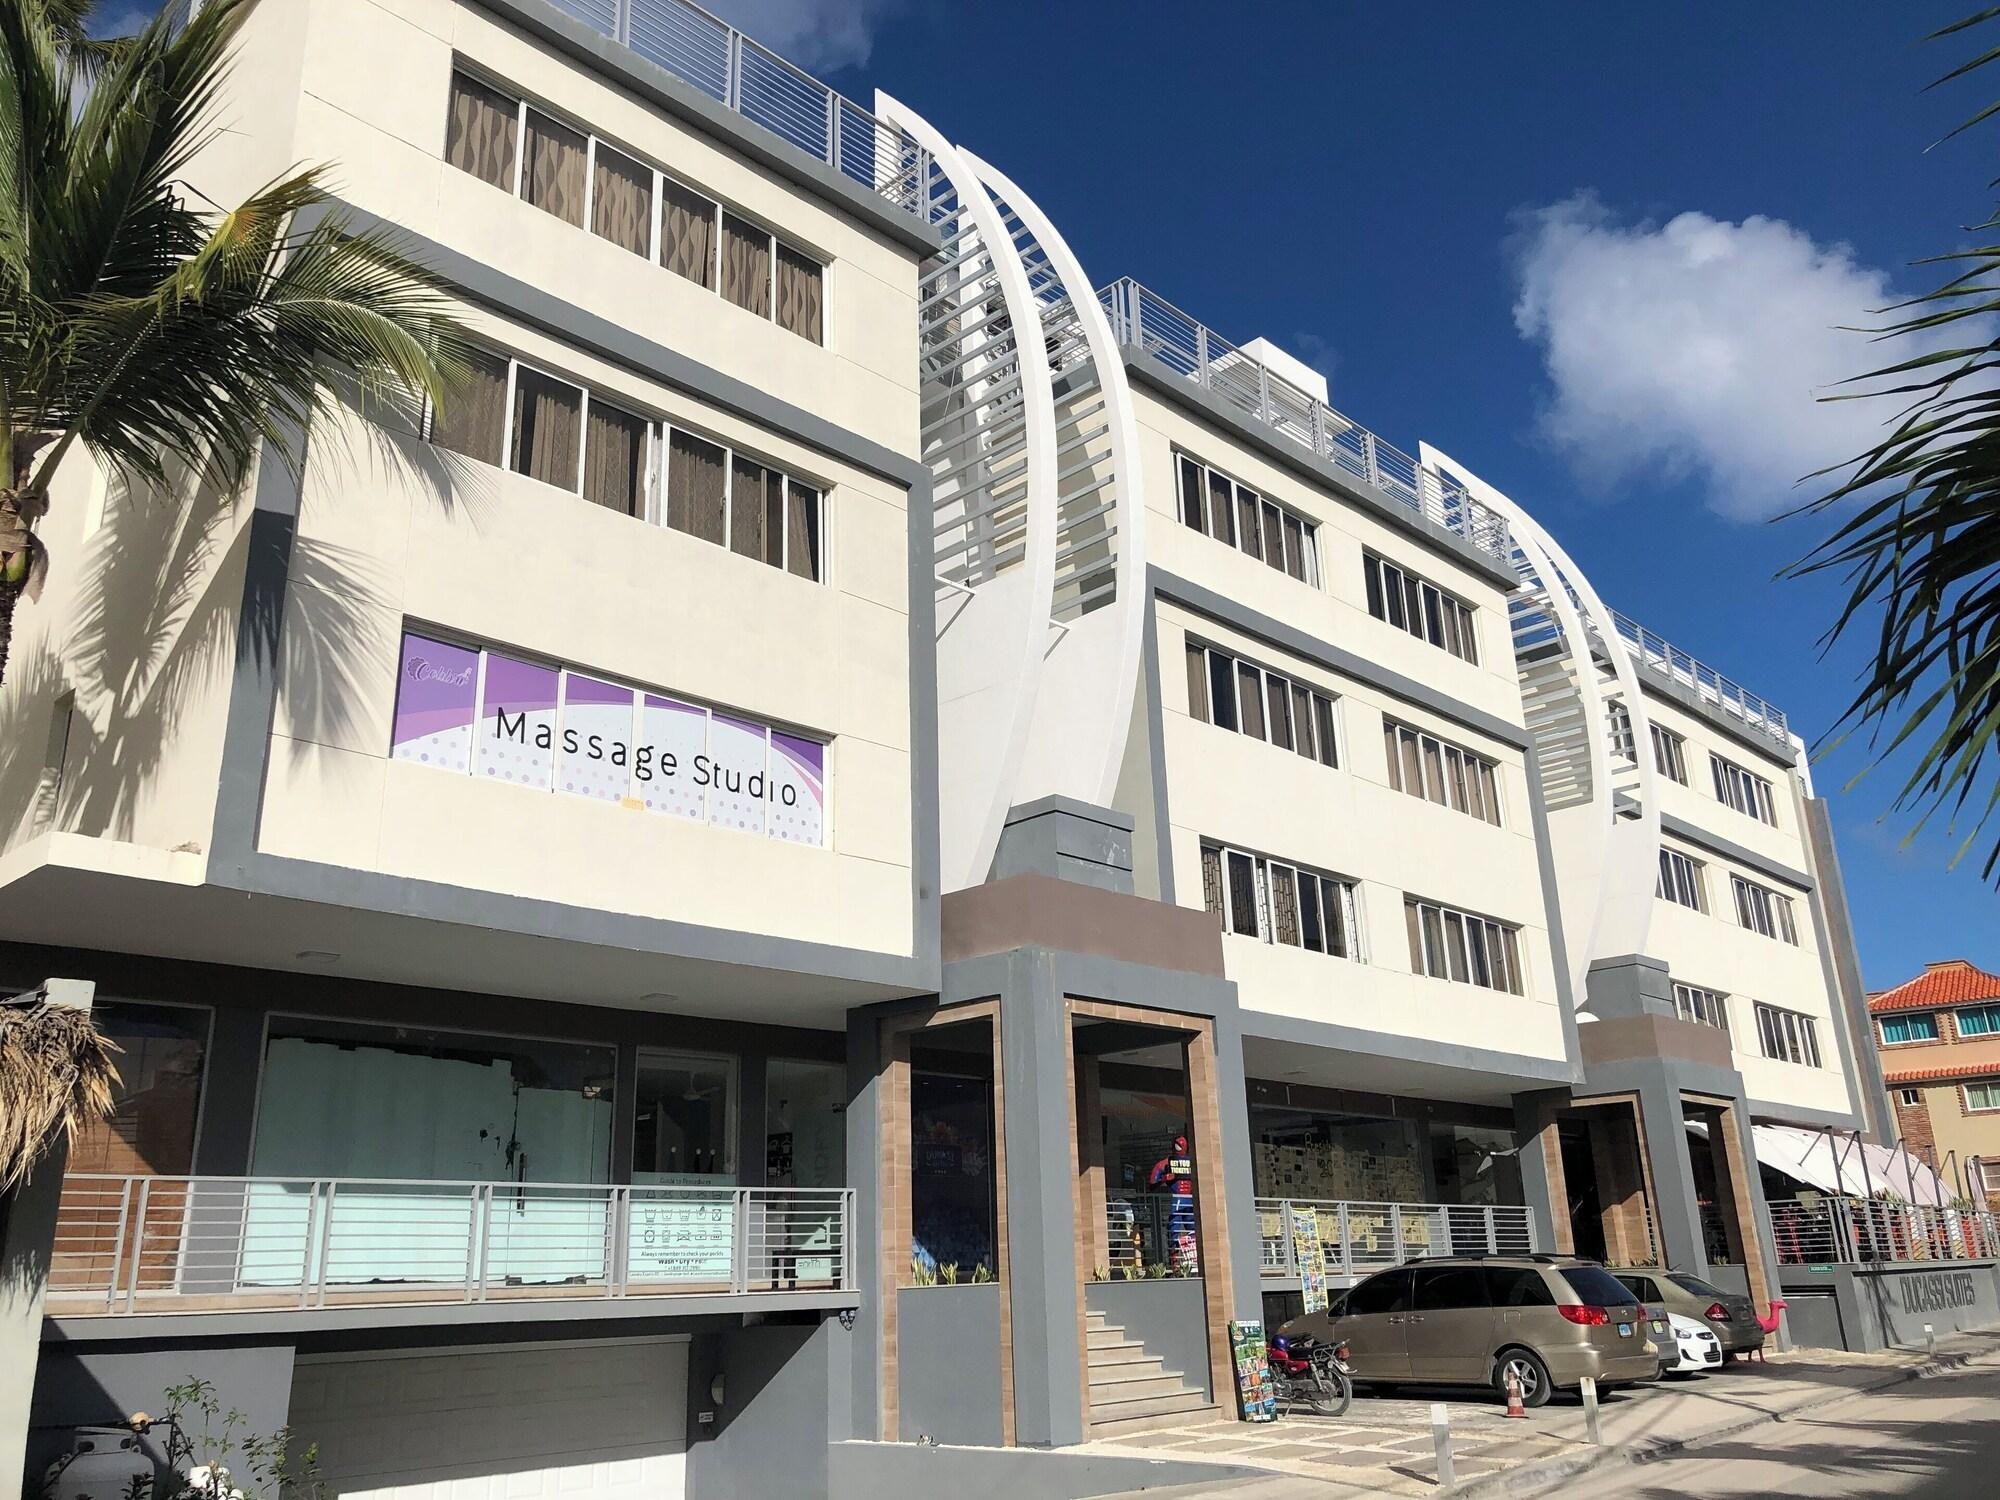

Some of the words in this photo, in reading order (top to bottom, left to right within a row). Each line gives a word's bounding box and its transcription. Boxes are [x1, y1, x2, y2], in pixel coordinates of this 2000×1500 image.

[496, 707, 678, 781] Massage
[693, 754, 797, 806] Studio
[1943, 1273, 1976, 1309] SUITES
